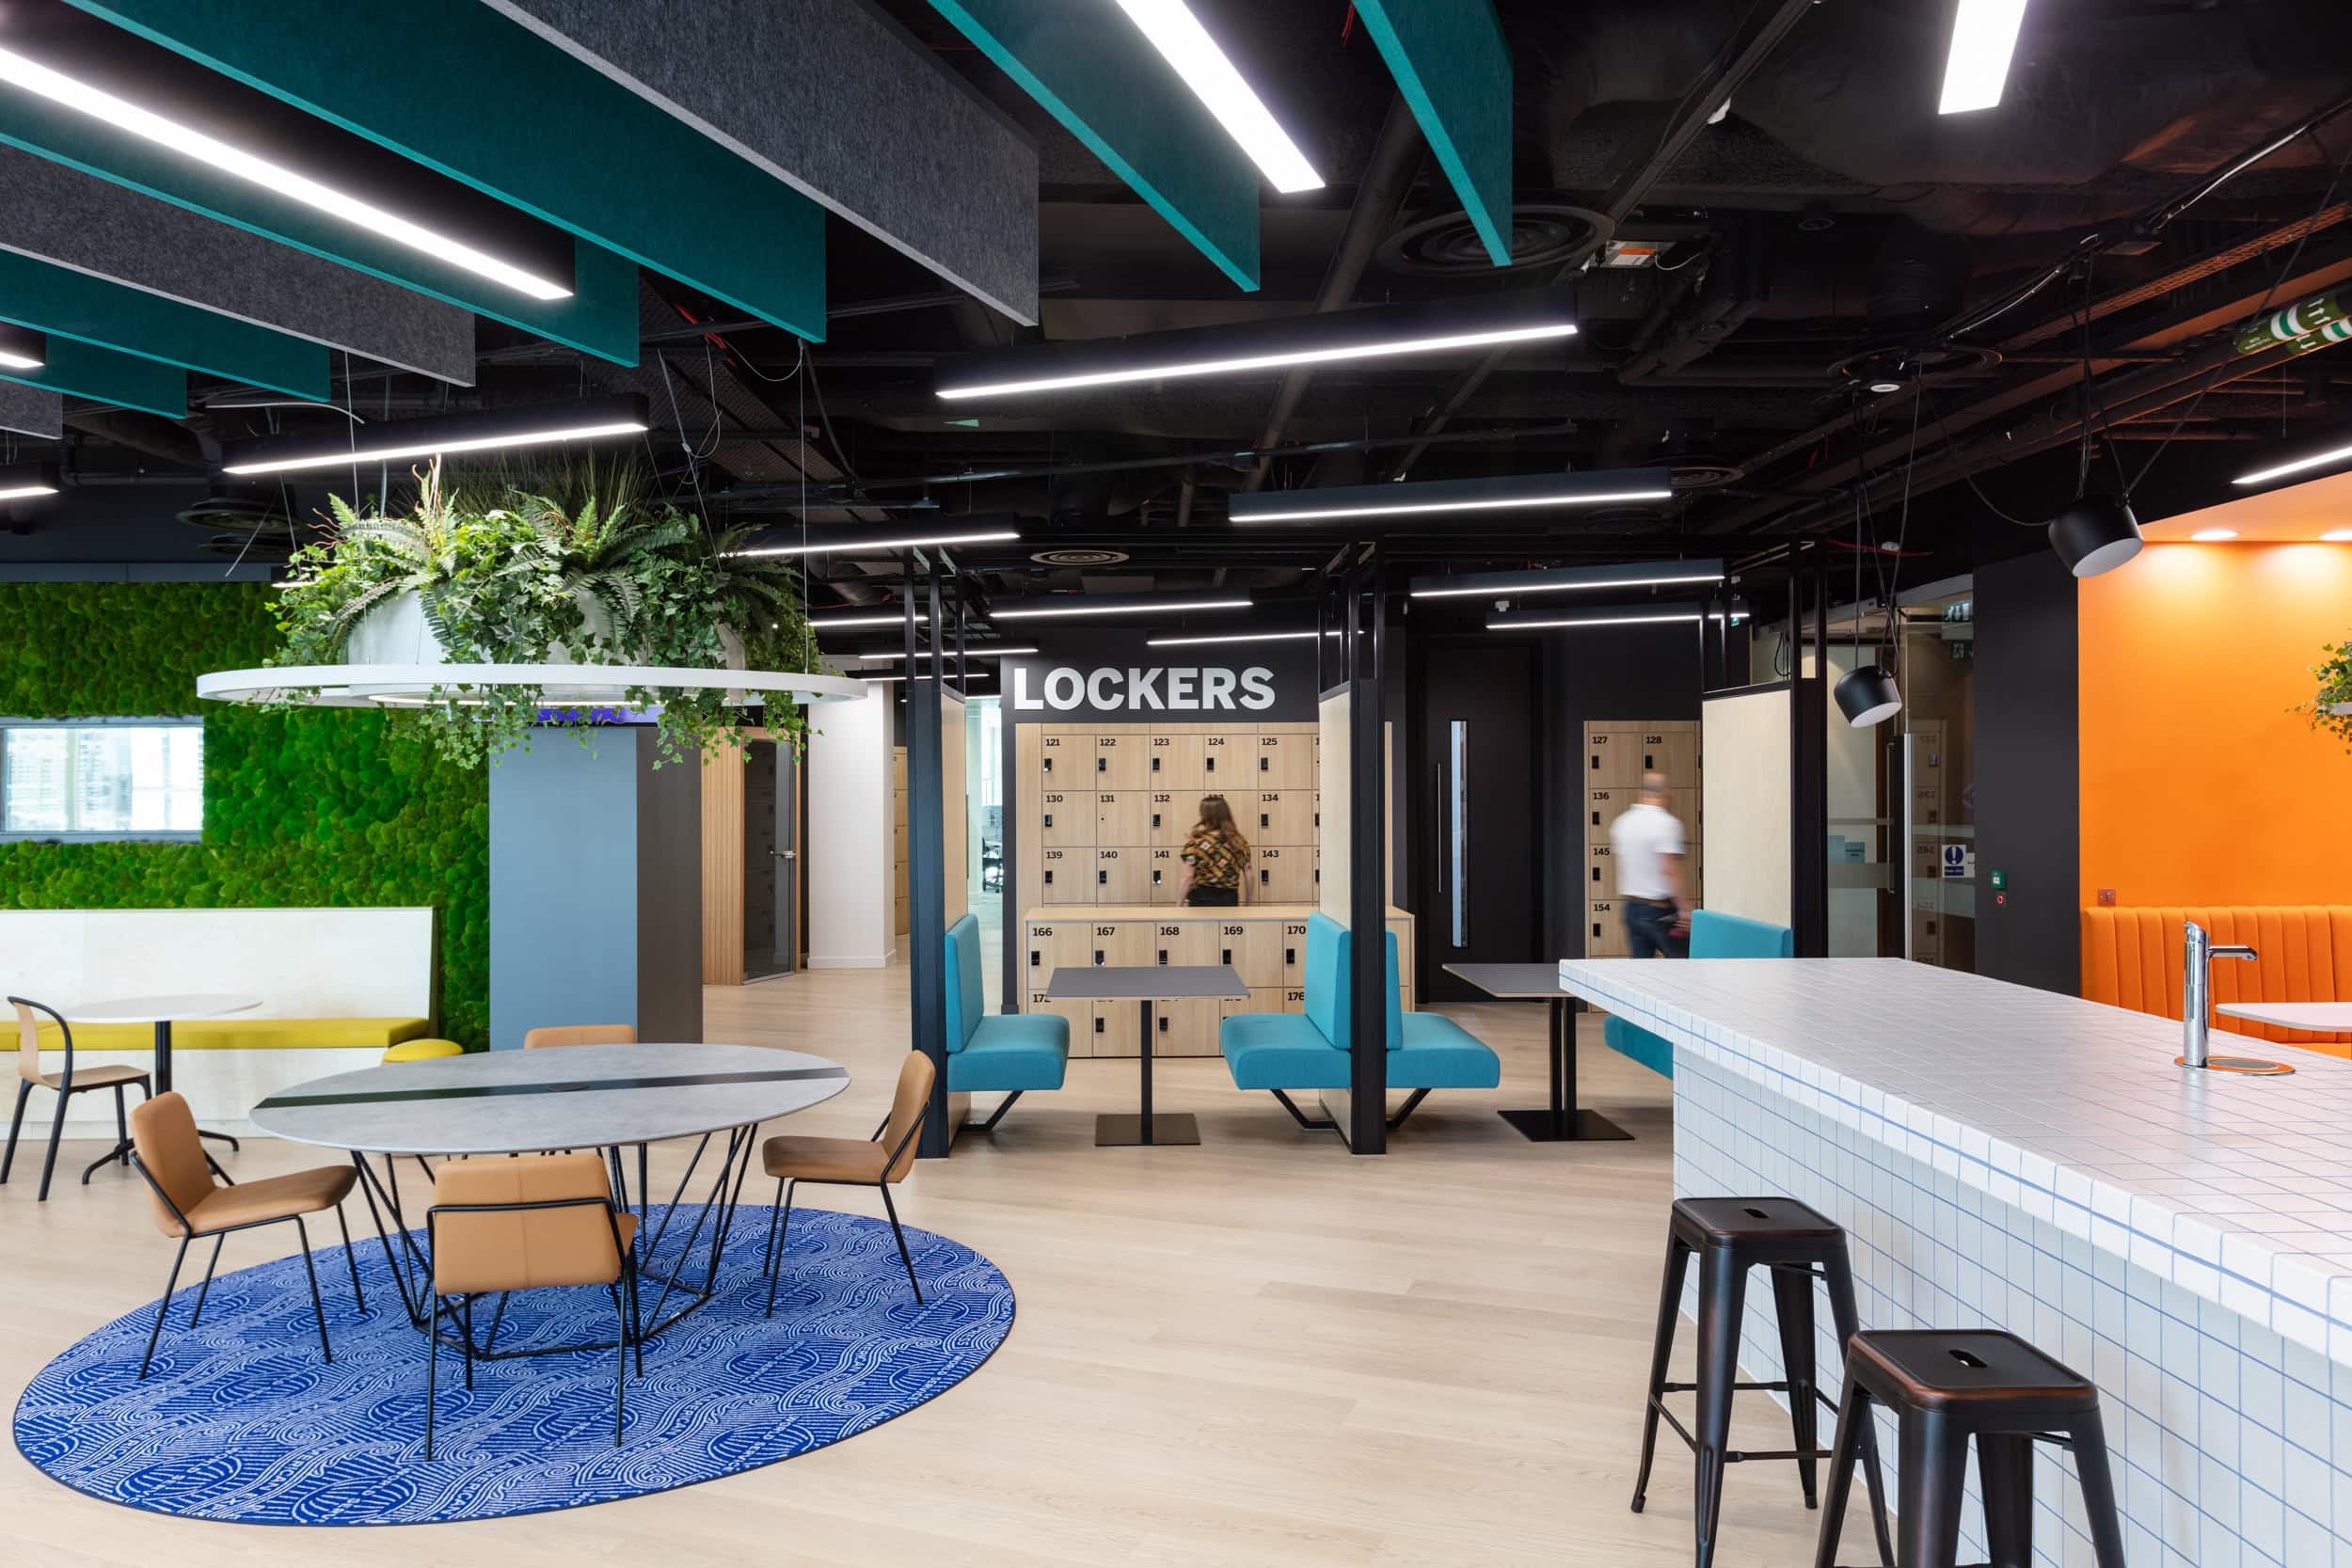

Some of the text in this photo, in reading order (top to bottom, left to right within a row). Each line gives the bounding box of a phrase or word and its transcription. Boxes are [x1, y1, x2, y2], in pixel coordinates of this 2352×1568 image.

[1014, 667, 1276, 710] LOCKERS
[1045, 738, 1060, 747] 121
[1100, 738, 1117, 747] 122
[1153, 737, 1170, 747] 123
[1207, 737, 1225, 747] 124
[1261, 736, 1279, 746] 125
[1592, 736, 1608, 745] 127
[1645, 736, 1662, 745] 128
[1045, 794, 1064, 803] 130
[1099, 794, 1116, 803] 131
[1153, 794, 1171, 803] 132
[1262, 793, 1279, 802] 134
[1593, 791, 1610, 800] 136
[1045, 850, 1063, 860] 139
[1100, 850, 1119, 859] 140
[1154, 849, 1170, 859] 141
[1262, 849, 1279, 859] 143
[1593, 847, 1611, 856] 145
[1594, 903, 1612, 912] 154
[1032, 927, 1053, 937] 166
[1096, 927, 1116, 937] 167
[1160, 926, 1180, 936] 168
[1223, 926, 1244, 936] 169
[1287, 925, 1307, 935] 170
